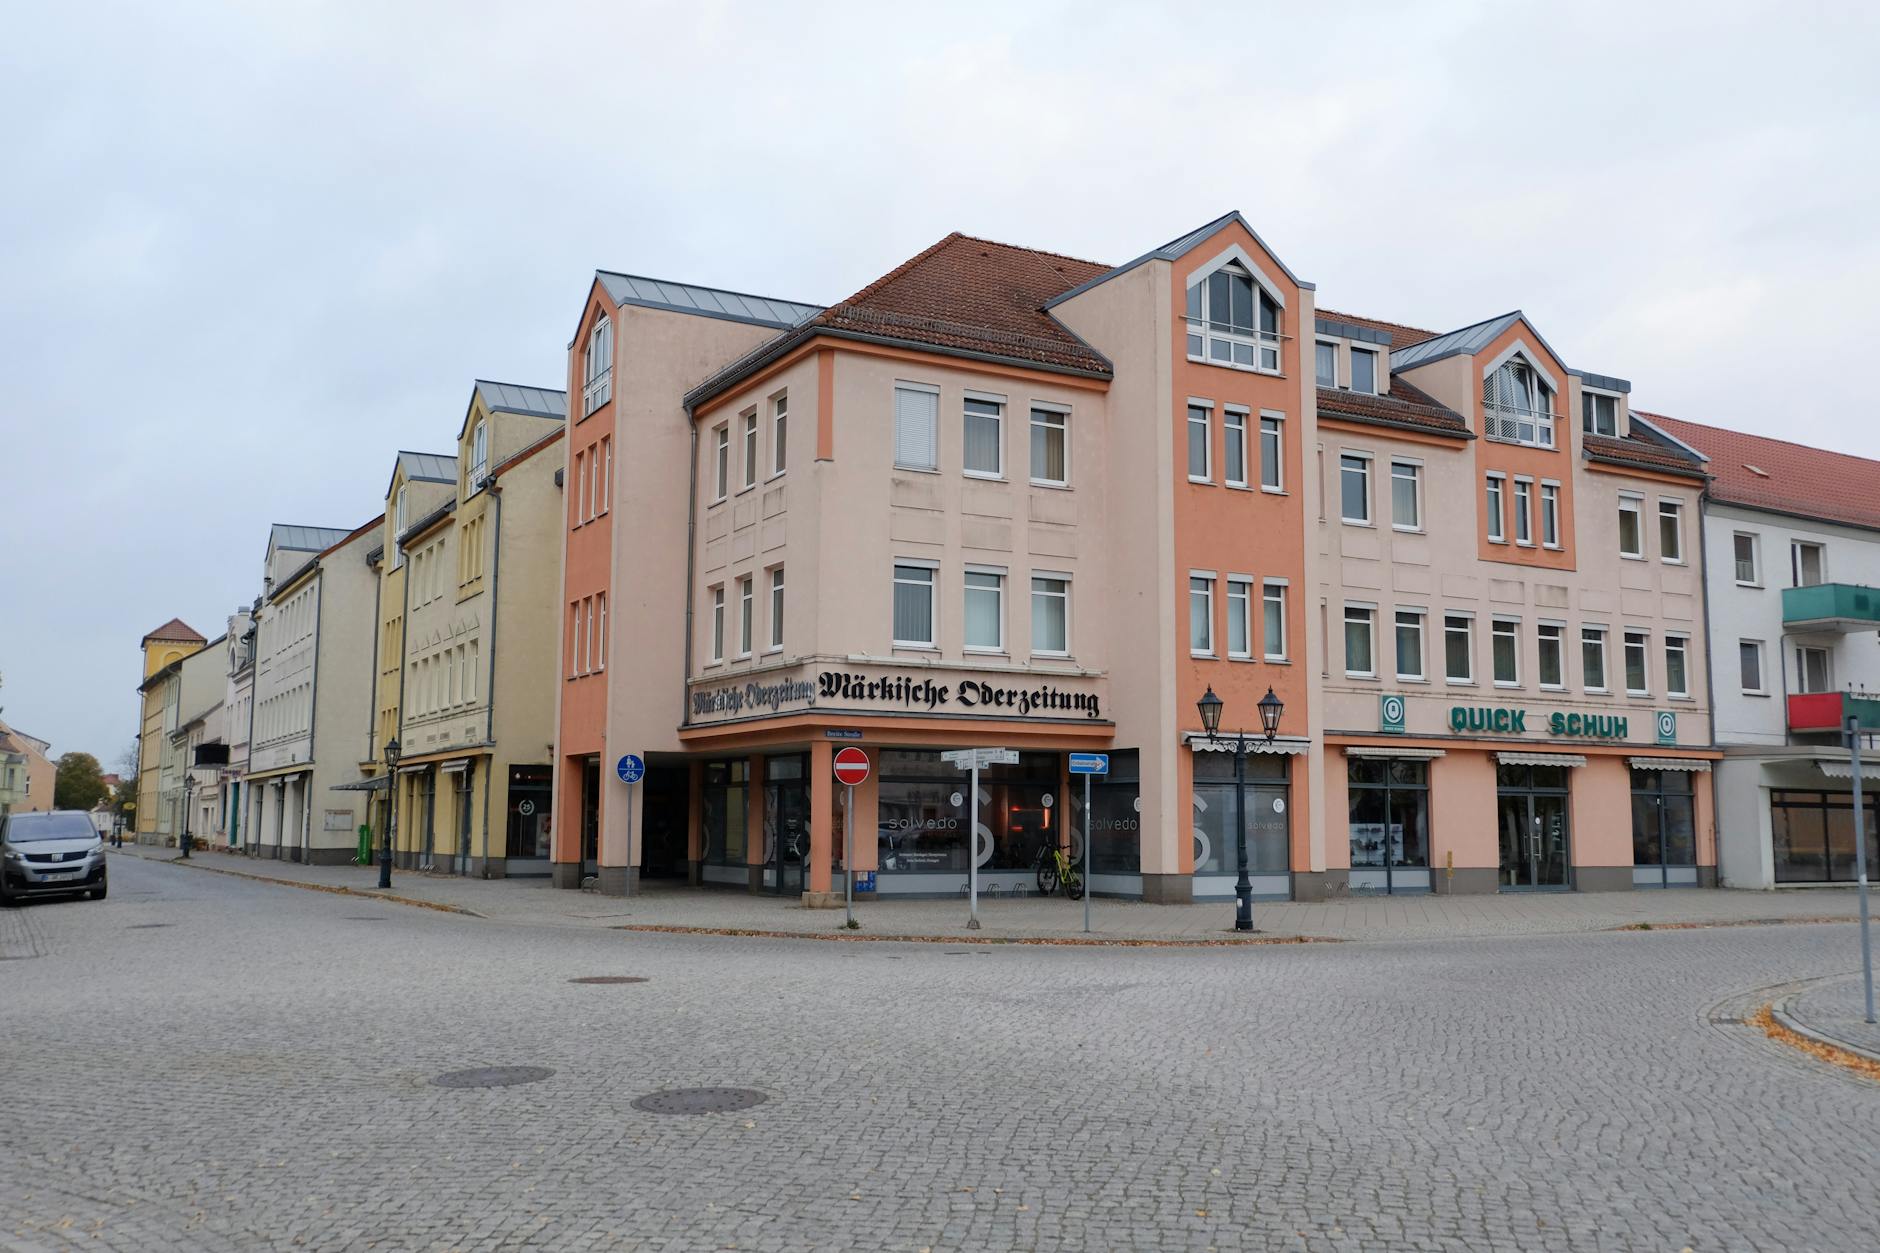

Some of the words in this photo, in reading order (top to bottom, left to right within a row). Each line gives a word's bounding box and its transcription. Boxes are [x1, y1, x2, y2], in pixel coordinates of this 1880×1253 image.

[957, 680, 1100, 718] Oderzeitung
[1450, 706, 1527, 733] QUICK
[1550, 711, 1628, 738] SCHUH
[889, 816, 957, 829] solvedo
[1090, 818, 1138, 831] solvedo
